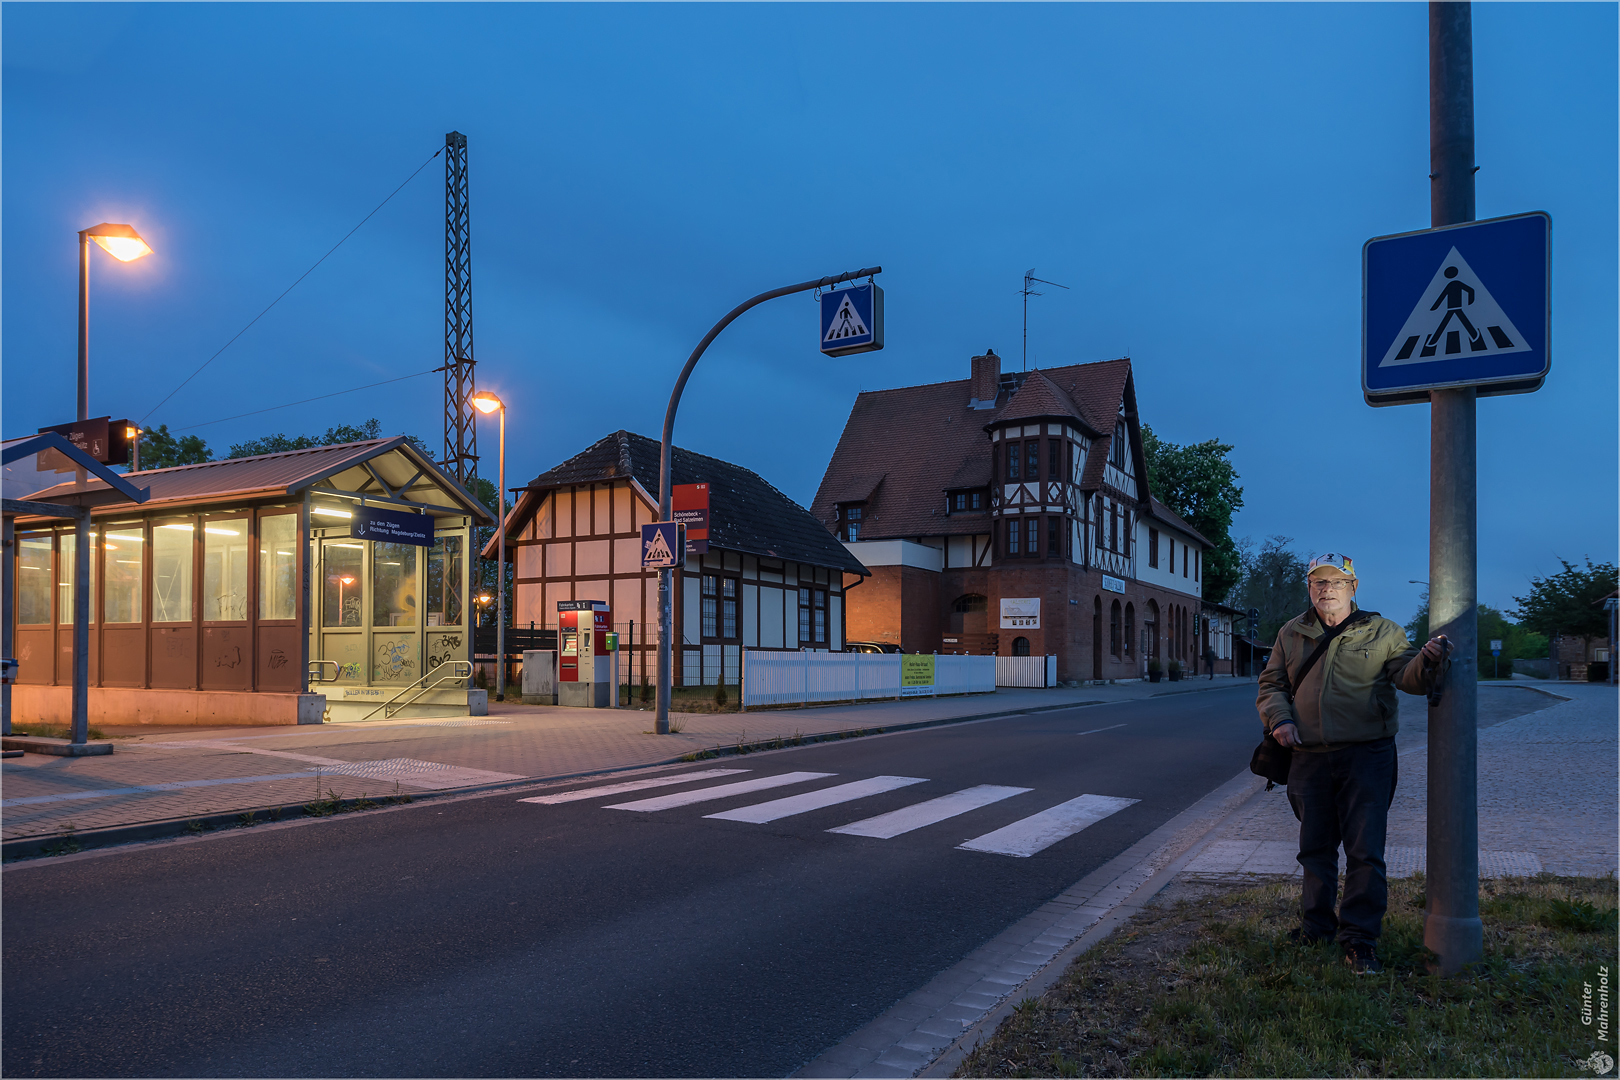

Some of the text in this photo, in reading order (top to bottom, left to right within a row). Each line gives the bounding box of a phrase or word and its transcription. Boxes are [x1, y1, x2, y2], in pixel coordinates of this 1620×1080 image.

[69, 432, 84, 442] Zügen
[386, 521, 400, 529] Zügen
[370, 526, 389, 535] Richtung
